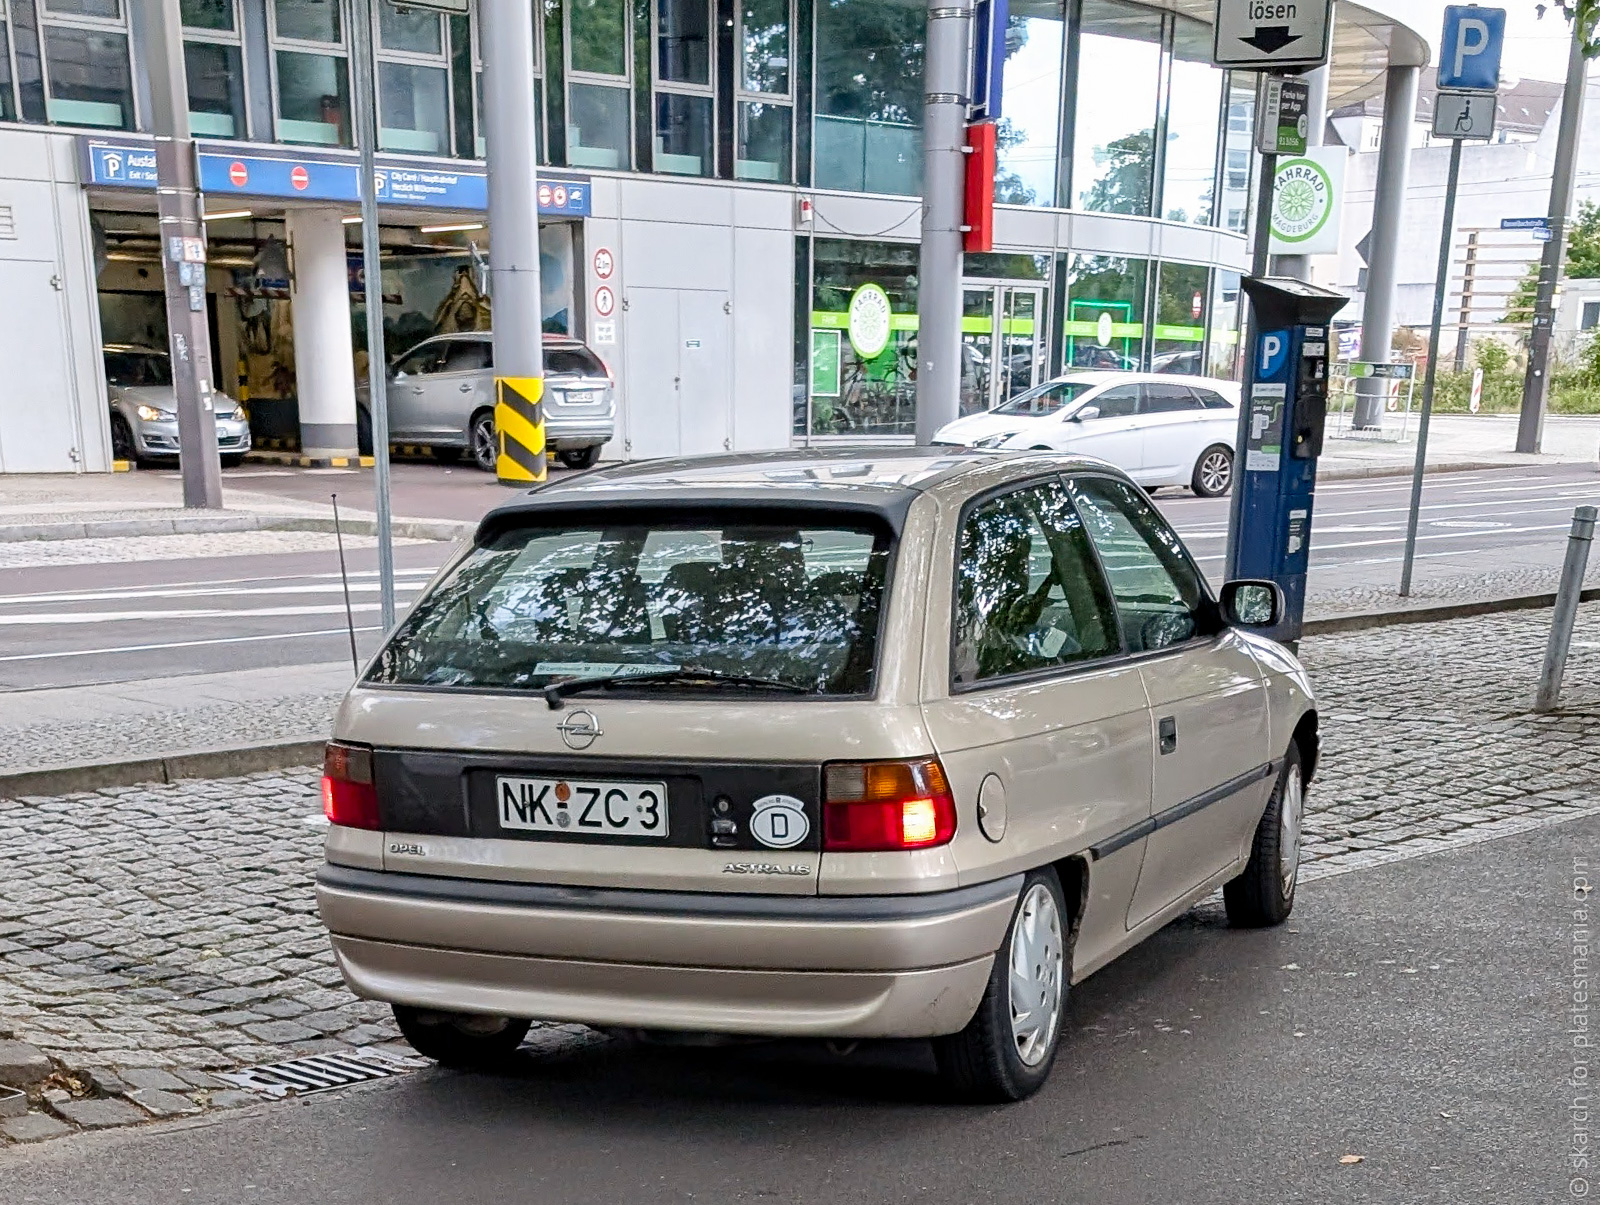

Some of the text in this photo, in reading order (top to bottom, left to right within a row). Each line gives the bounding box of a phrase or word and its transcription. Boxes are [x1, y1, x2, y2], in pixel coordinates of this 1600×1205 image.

[1249, 1, 1296, 20] lösen
[1453, 18, 1489, 78] P
[1272, 213, 1319, 233] MAGDEBURG
[1262, 335, 1281, 370] P
[771, 813, 788, 838] D
[390, 843, 426, 856] OPEL
